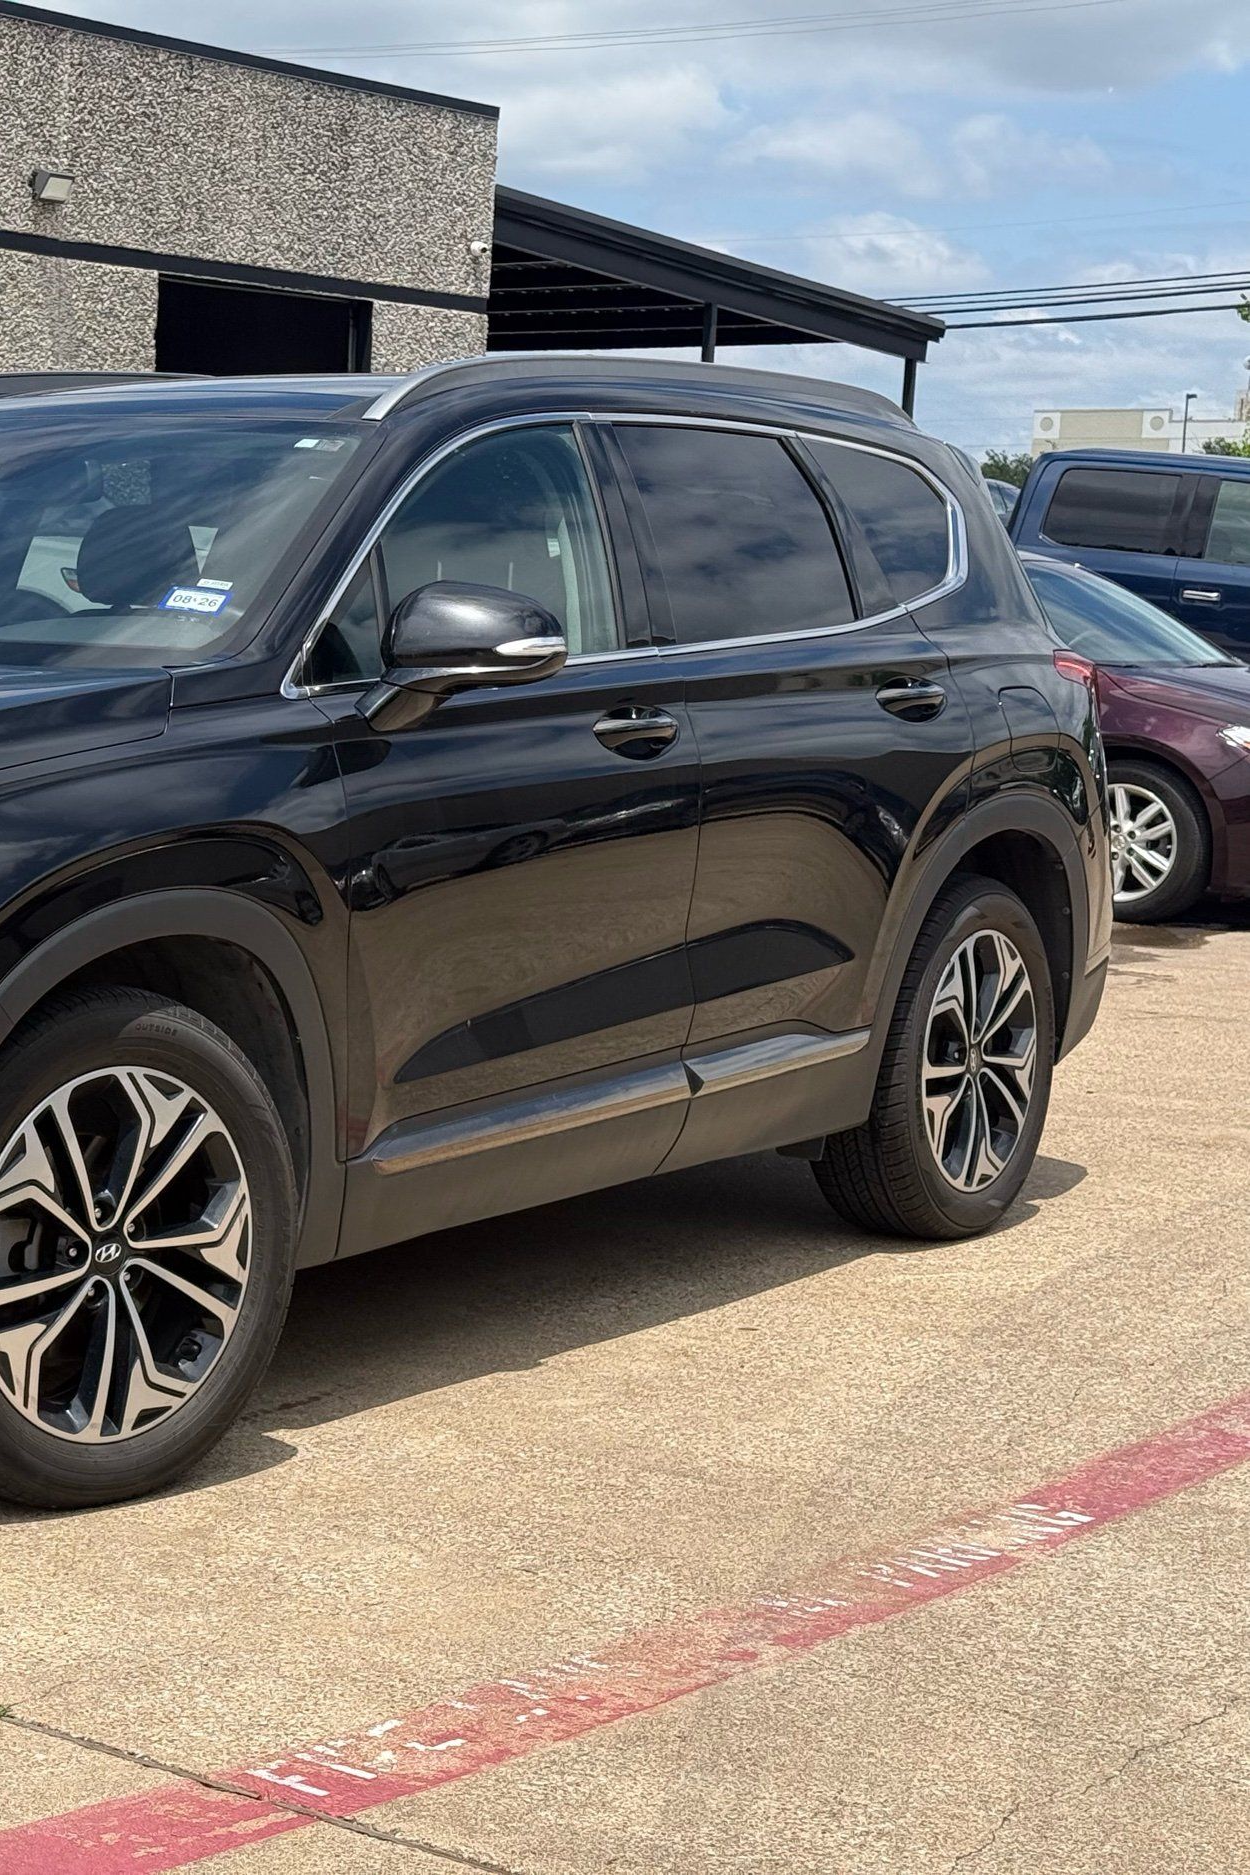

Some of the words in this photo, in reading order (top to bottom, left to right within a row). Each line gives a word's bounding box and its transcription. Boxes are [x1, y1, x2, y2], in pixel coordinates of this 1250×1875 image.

[172, 594, 192, 604] 08
[197, 597, 219, 608] 26
[134, 1023, 178, 1036] OUTSIDE
[854, 1502, 1096, 1589] PARNG
